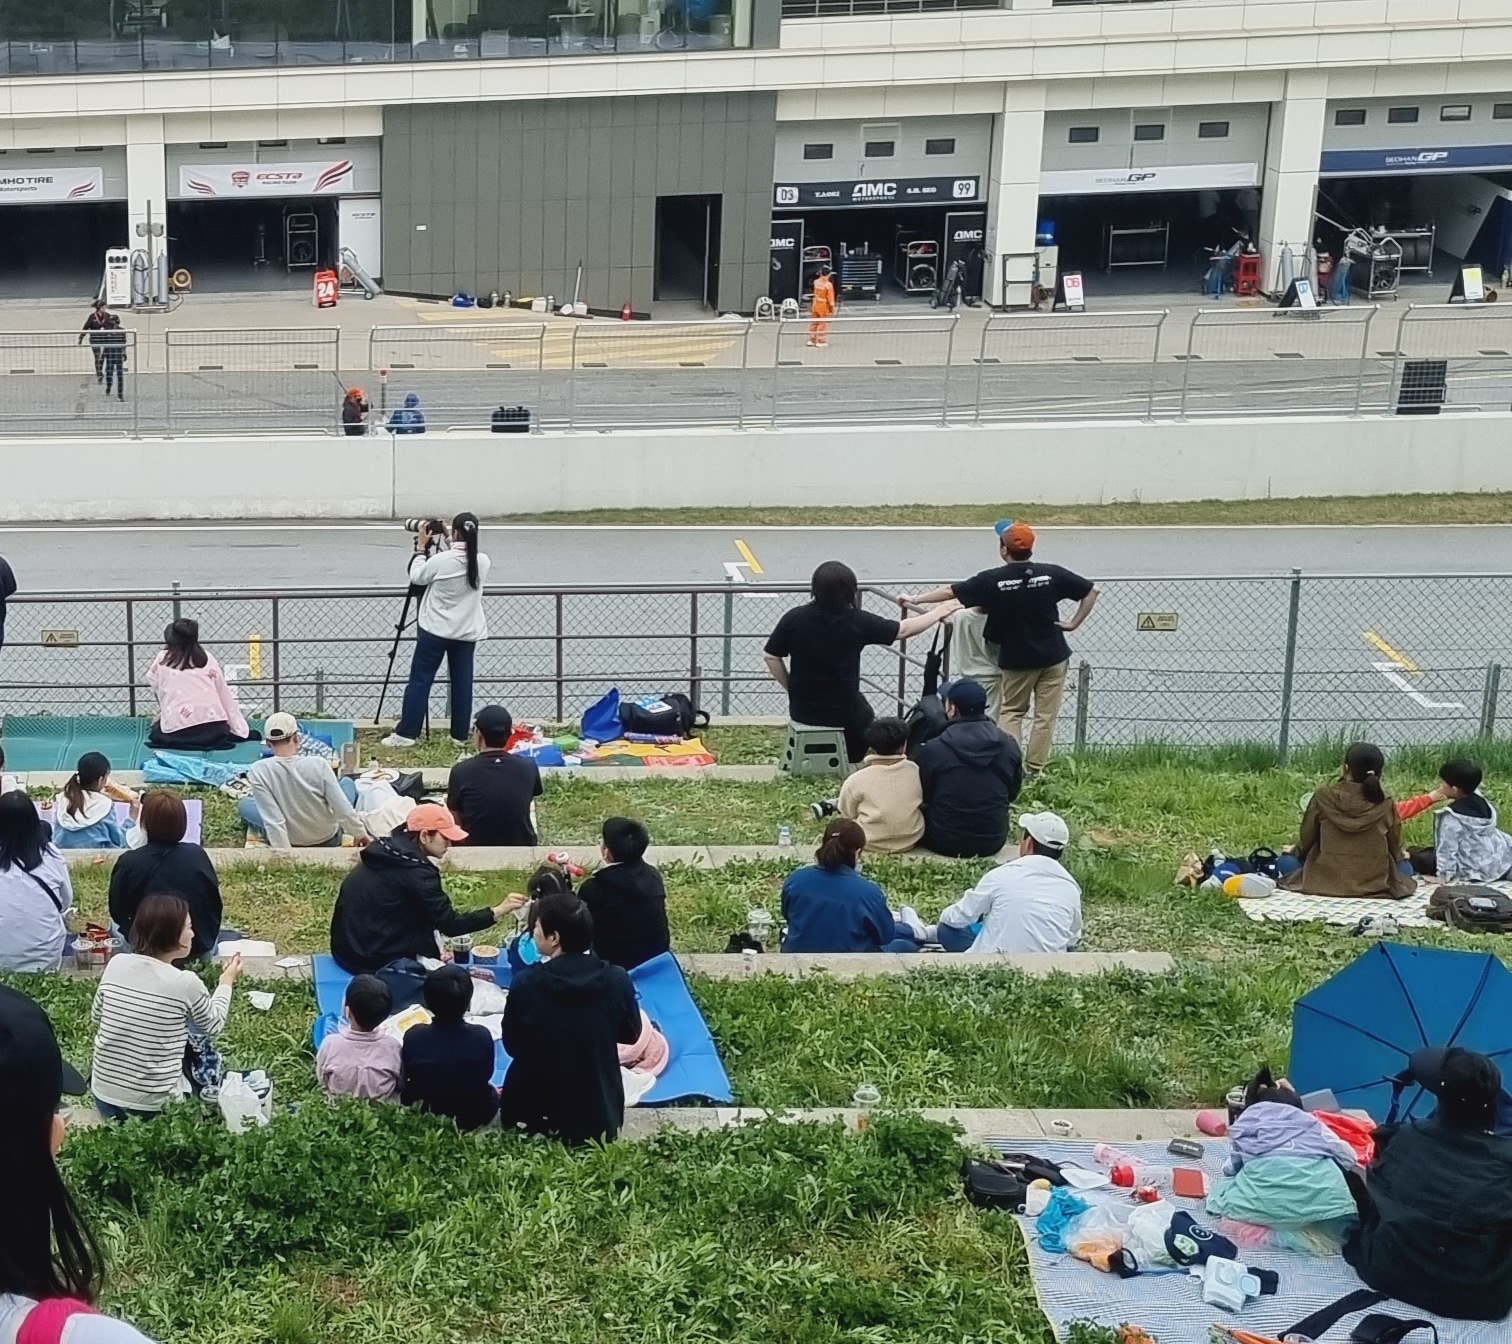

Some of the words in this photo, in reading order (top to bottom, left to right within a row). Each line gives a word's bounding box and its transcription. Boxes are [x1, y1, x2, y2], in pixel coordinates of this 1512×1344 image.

[25, 176, 54, 185] TIRE
[851, 182, 897, 197] AMC
[957, 182, 972, 196] 99
[318, 280, 335, 298] 24
